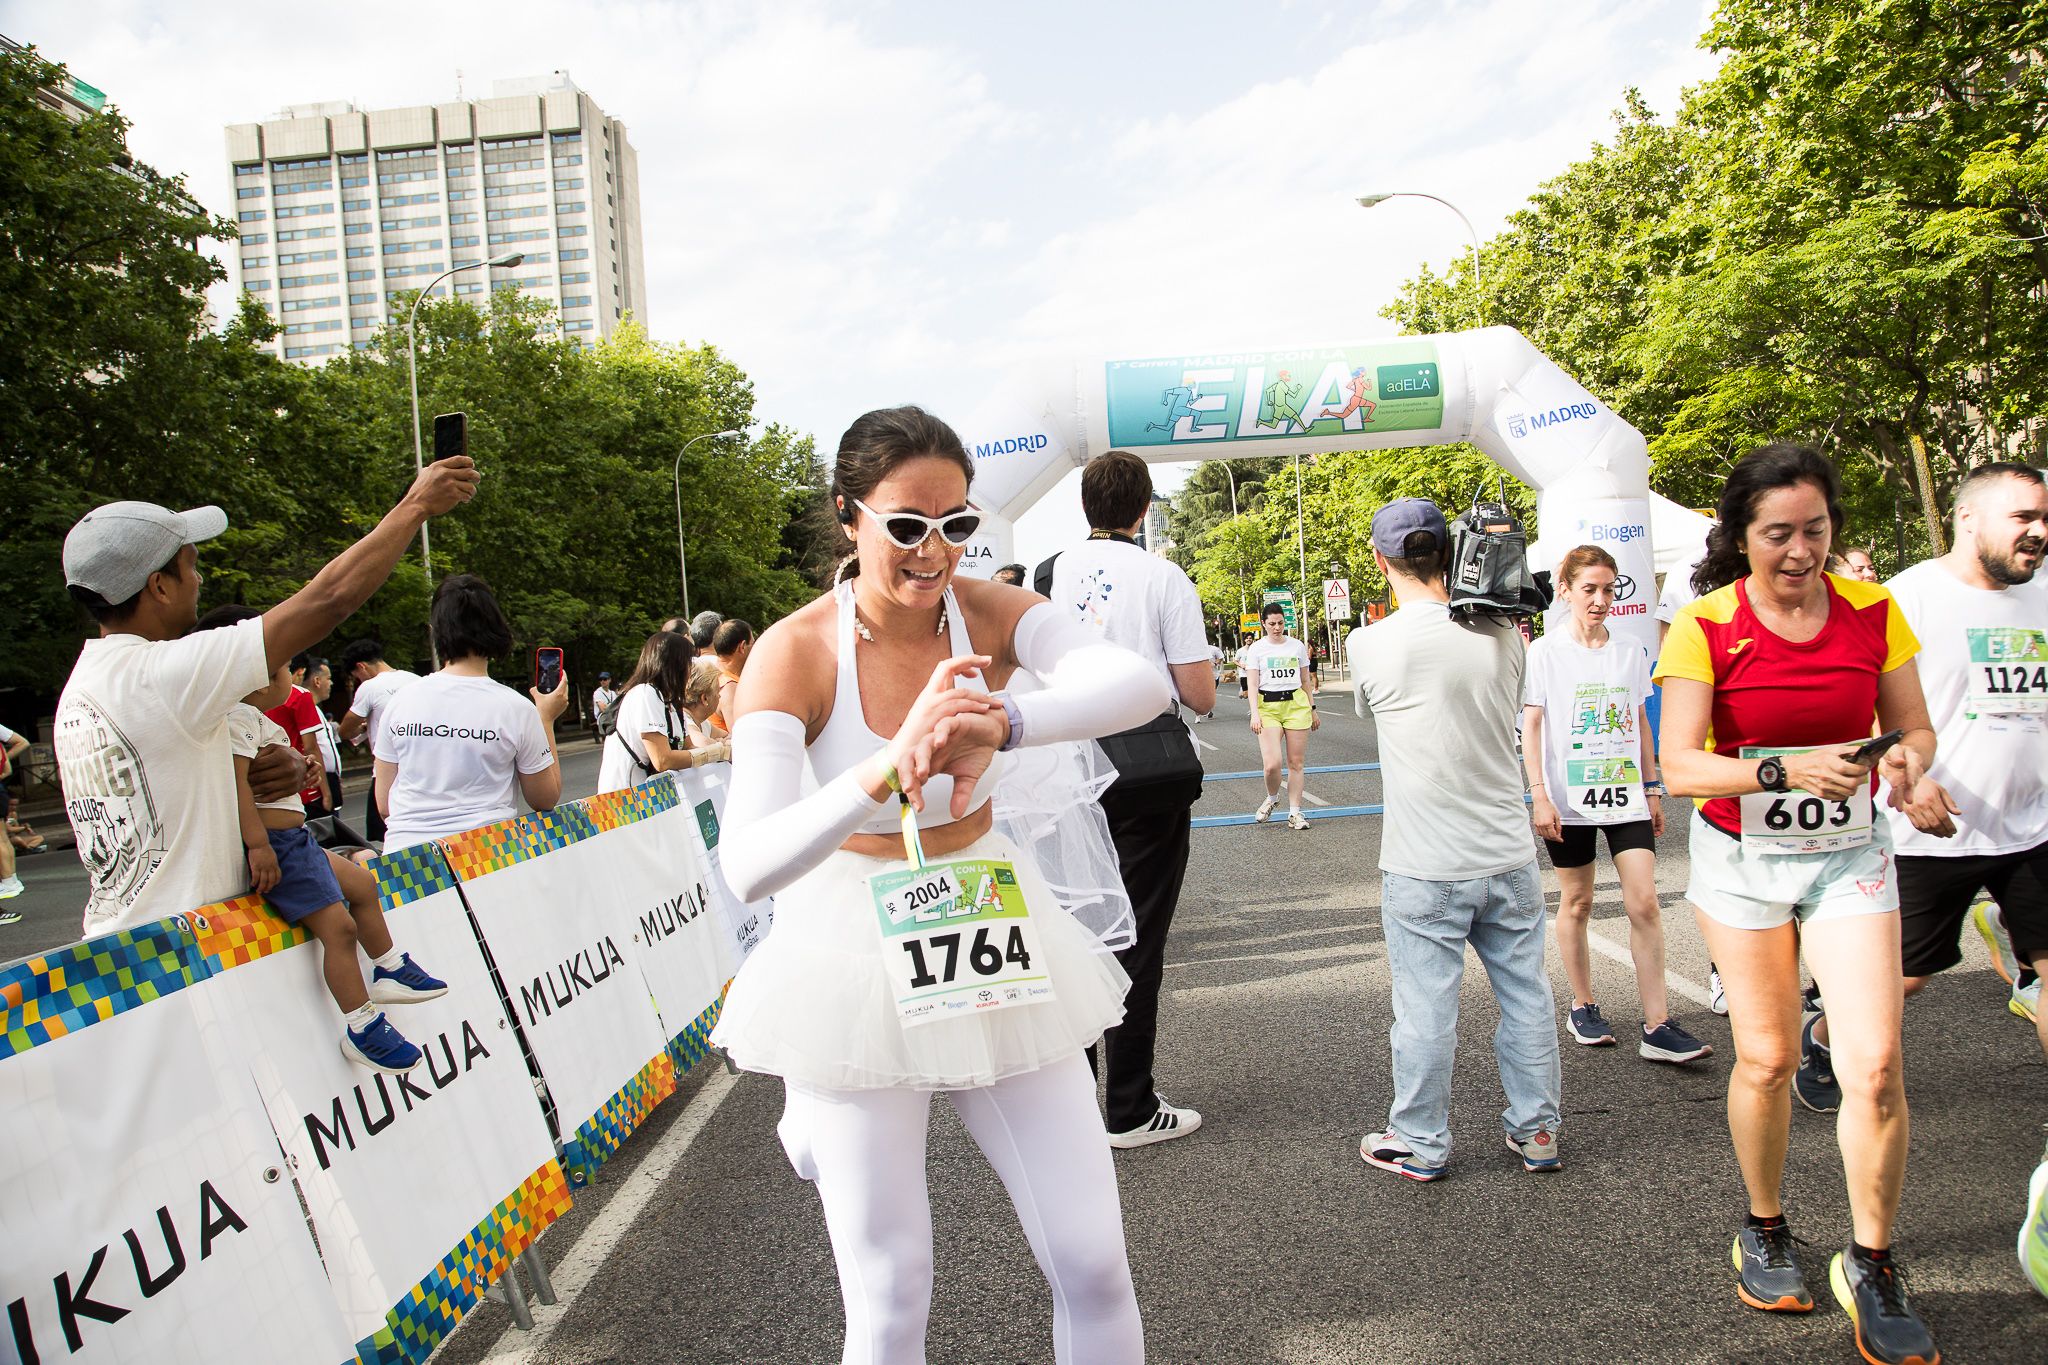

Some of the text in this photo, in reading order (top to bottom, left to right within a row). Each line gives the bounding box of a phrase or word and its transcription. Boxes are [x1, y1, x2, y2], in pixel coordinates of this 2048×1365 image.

[1184, 353, 1265, 367] MADRID
[1271, 350, 1314, 362] CON
[1320, 349, 1346, 360] LA
[1387, 377, 1431, 393] adELA
[1171, 361, 1365, 442] ELA
[1530, 403, 1597, 430] MADRID
[976, 434, 1048, 458] MADRID
[1592, 525, 1645, 542] Biogen
[1988, 636, 2040, 659] ELA
[1271, 669, 1296, 678] 1019
[1984, 666, 2048, 693] 1124
[1576, 688, 1607, 696] MADRID
[390, 723, 500, 743] VelillaGroup.
[1582, 764, 1626, 782] ELA
[1583, 787, 1629, 808] 445
[72, 799, 100, 823] CLUB
[1765, 798, 1851, 830] 603
[956, 865, 976, 875] CON
[977, 864, 989, 873] LA
[904, 876, 951, 911] 2004
[640, 882, 710, 947] MUKUA
[885, 902, 898, 915] 5K
[902, 925, 1031, 989] 1764
[520, 936, 625, 1027] MUKUA
[905, 1004, 935, 1015] MUKUA
[304, 1020, 490, 1170] MUKUA
[8, 1180, 248, 1365] KUA
